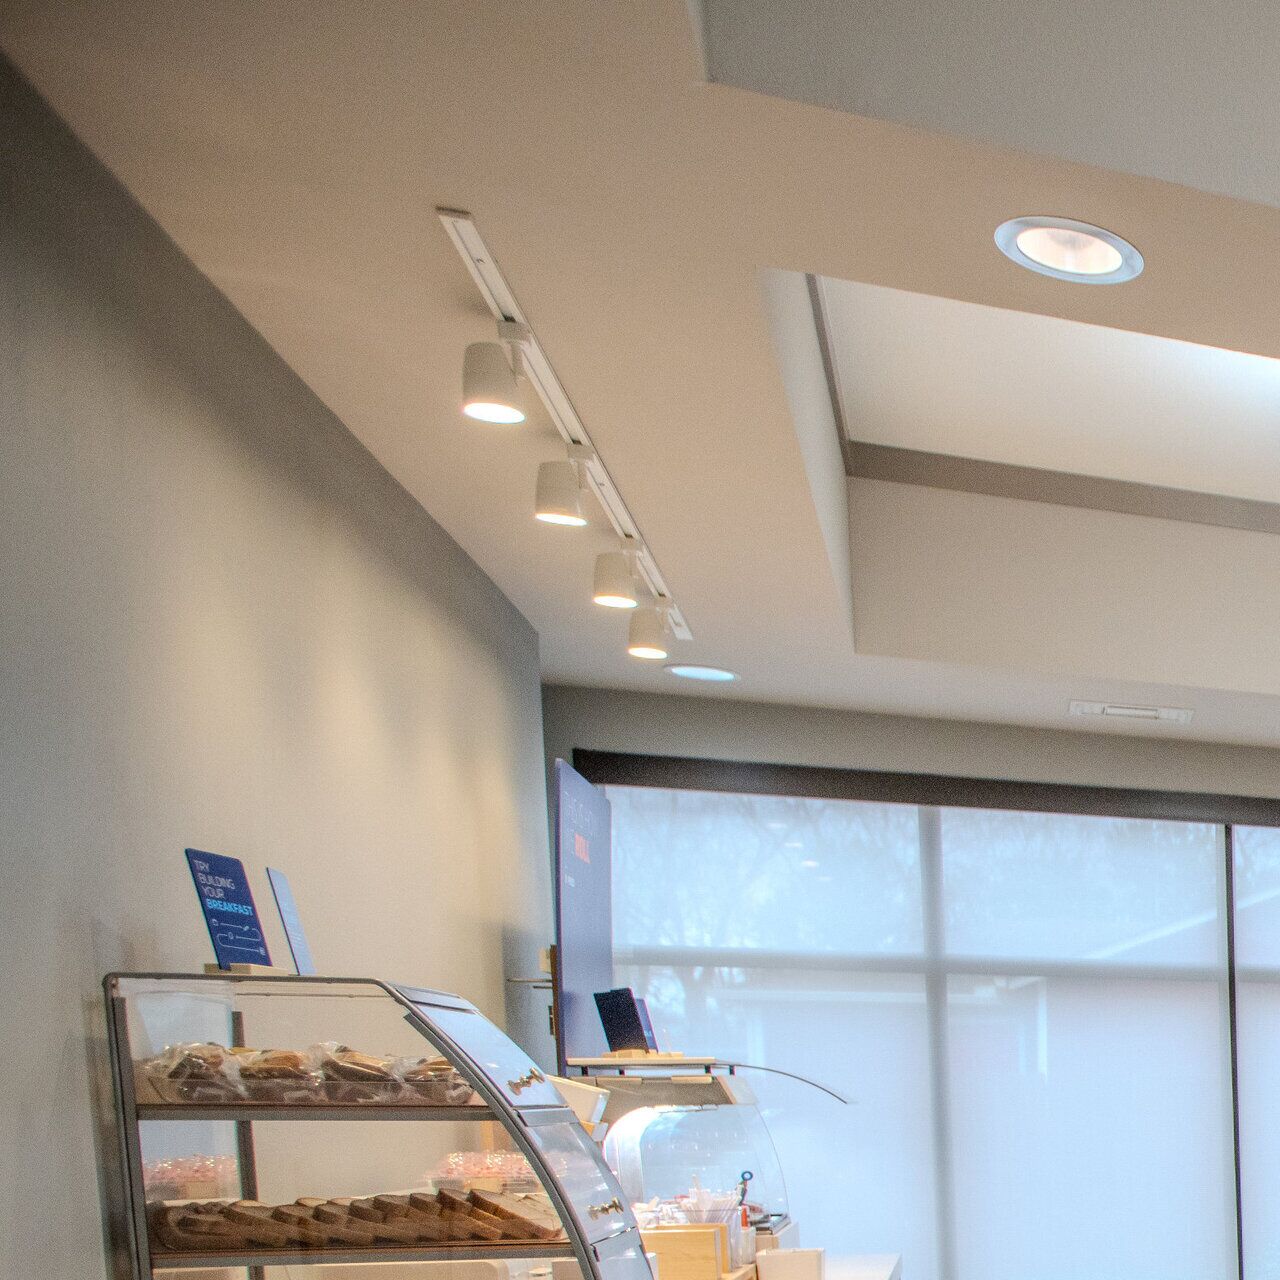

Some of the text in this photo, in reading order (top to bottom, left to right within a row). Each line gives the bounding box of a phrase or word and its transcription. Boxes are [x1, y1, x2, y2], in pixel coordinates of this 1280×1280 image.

[193, 859, 210, 873] TRY
[197, 872, 236, 890] BUILDING
[201, 885, 226, 900] YOUR
[206, 898, 254, 917] BREAKFAST
